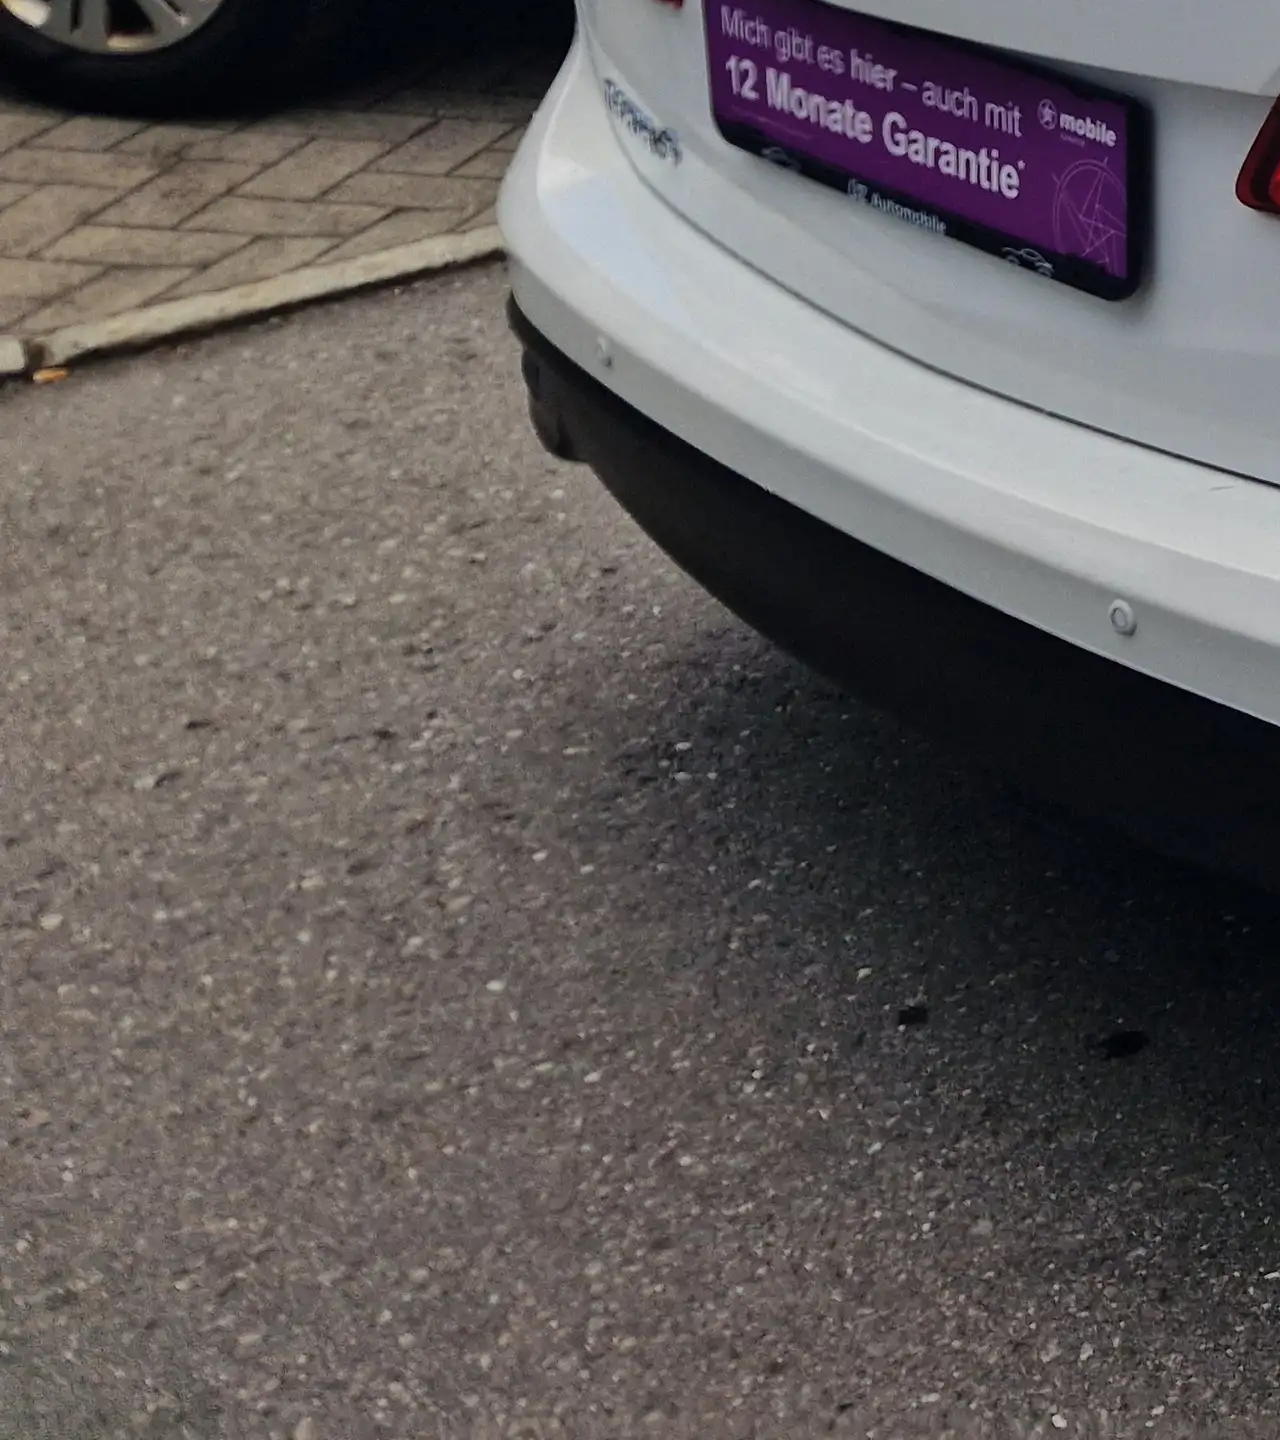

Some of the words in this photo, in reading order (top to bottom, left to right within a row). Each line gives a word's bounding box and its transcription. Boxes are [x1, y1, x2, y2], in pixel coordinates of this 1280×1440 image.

[721, 6, 769, 49] Mich
[775, 27, 814, 62] gibt
[817, 43, 844, 74] es
[851, 49, 897, 92] hier
[921, 80, 979, 122] auch
[985, 99, 1022, 137] mit
[725, 55, 760, 100] 12
[766, 68, 874, 144] Monate
[1060, 111, 1117, 147] mobile
